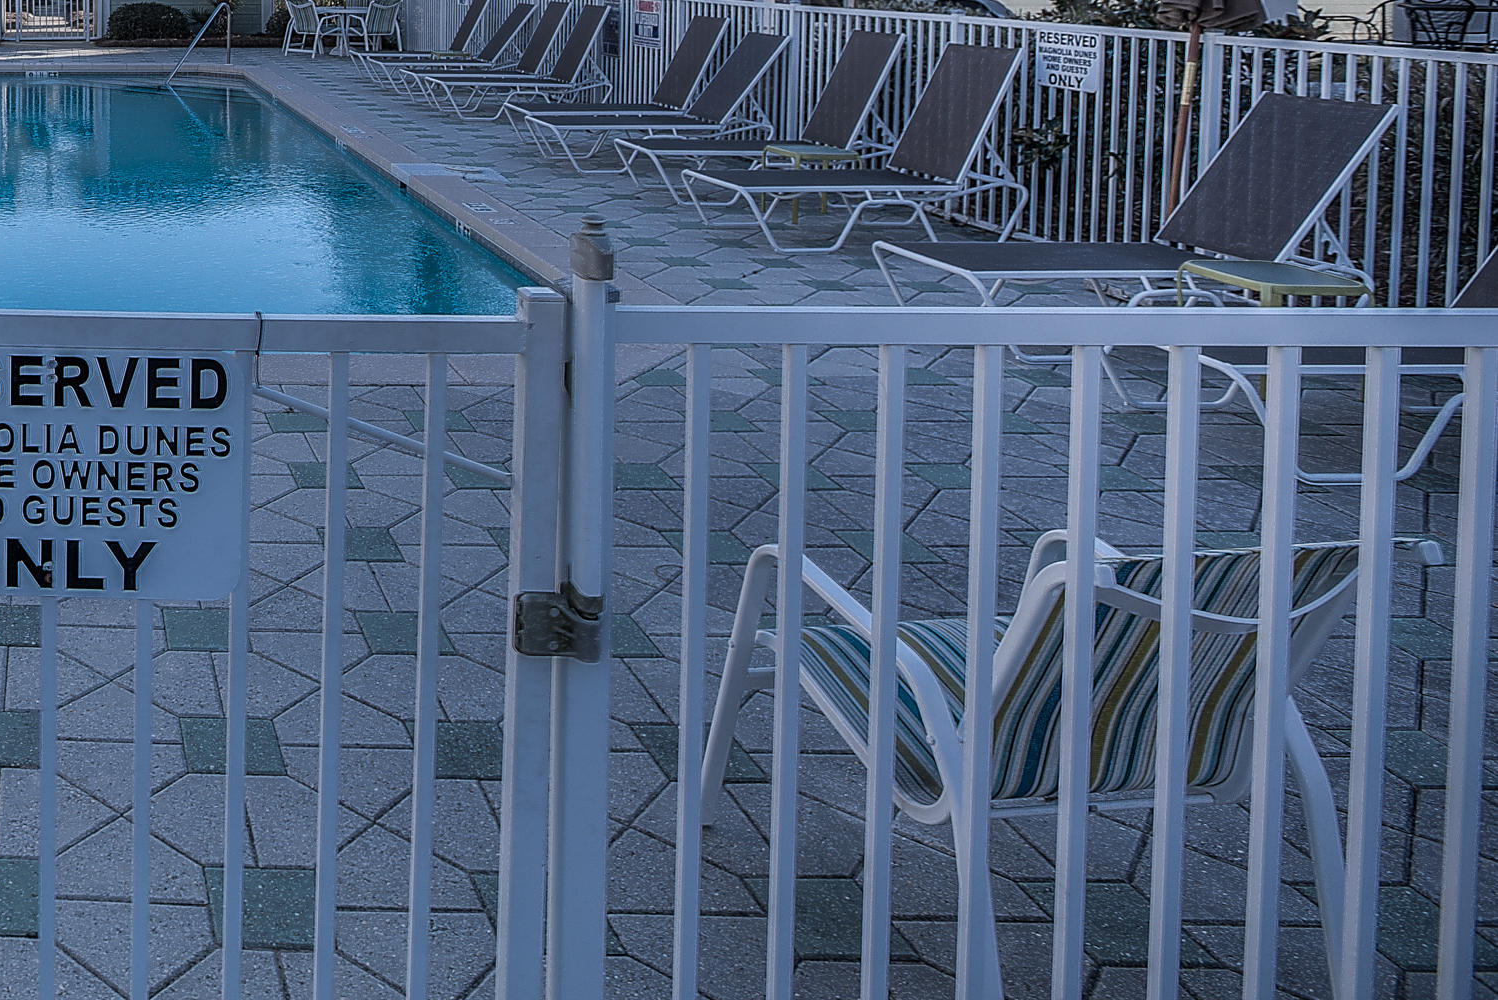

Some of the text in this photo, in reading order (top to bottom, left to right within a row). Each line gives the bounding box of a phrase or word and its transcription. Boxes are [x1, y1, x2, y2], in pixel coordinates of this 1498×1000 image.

[1039, 31, 1097, 48] RESERVED
[1038, 46, 1097, 59] MAGNOLIA DUNES
[1046, 63, 1088, 75] AND GUESTS
[1048, 73, 1084, 89] ONLY
[97, 424, 232, 458] DUNES
[32, 460, 200, 493] OWNERS
[22, 496, 179, 529] GUESTS
